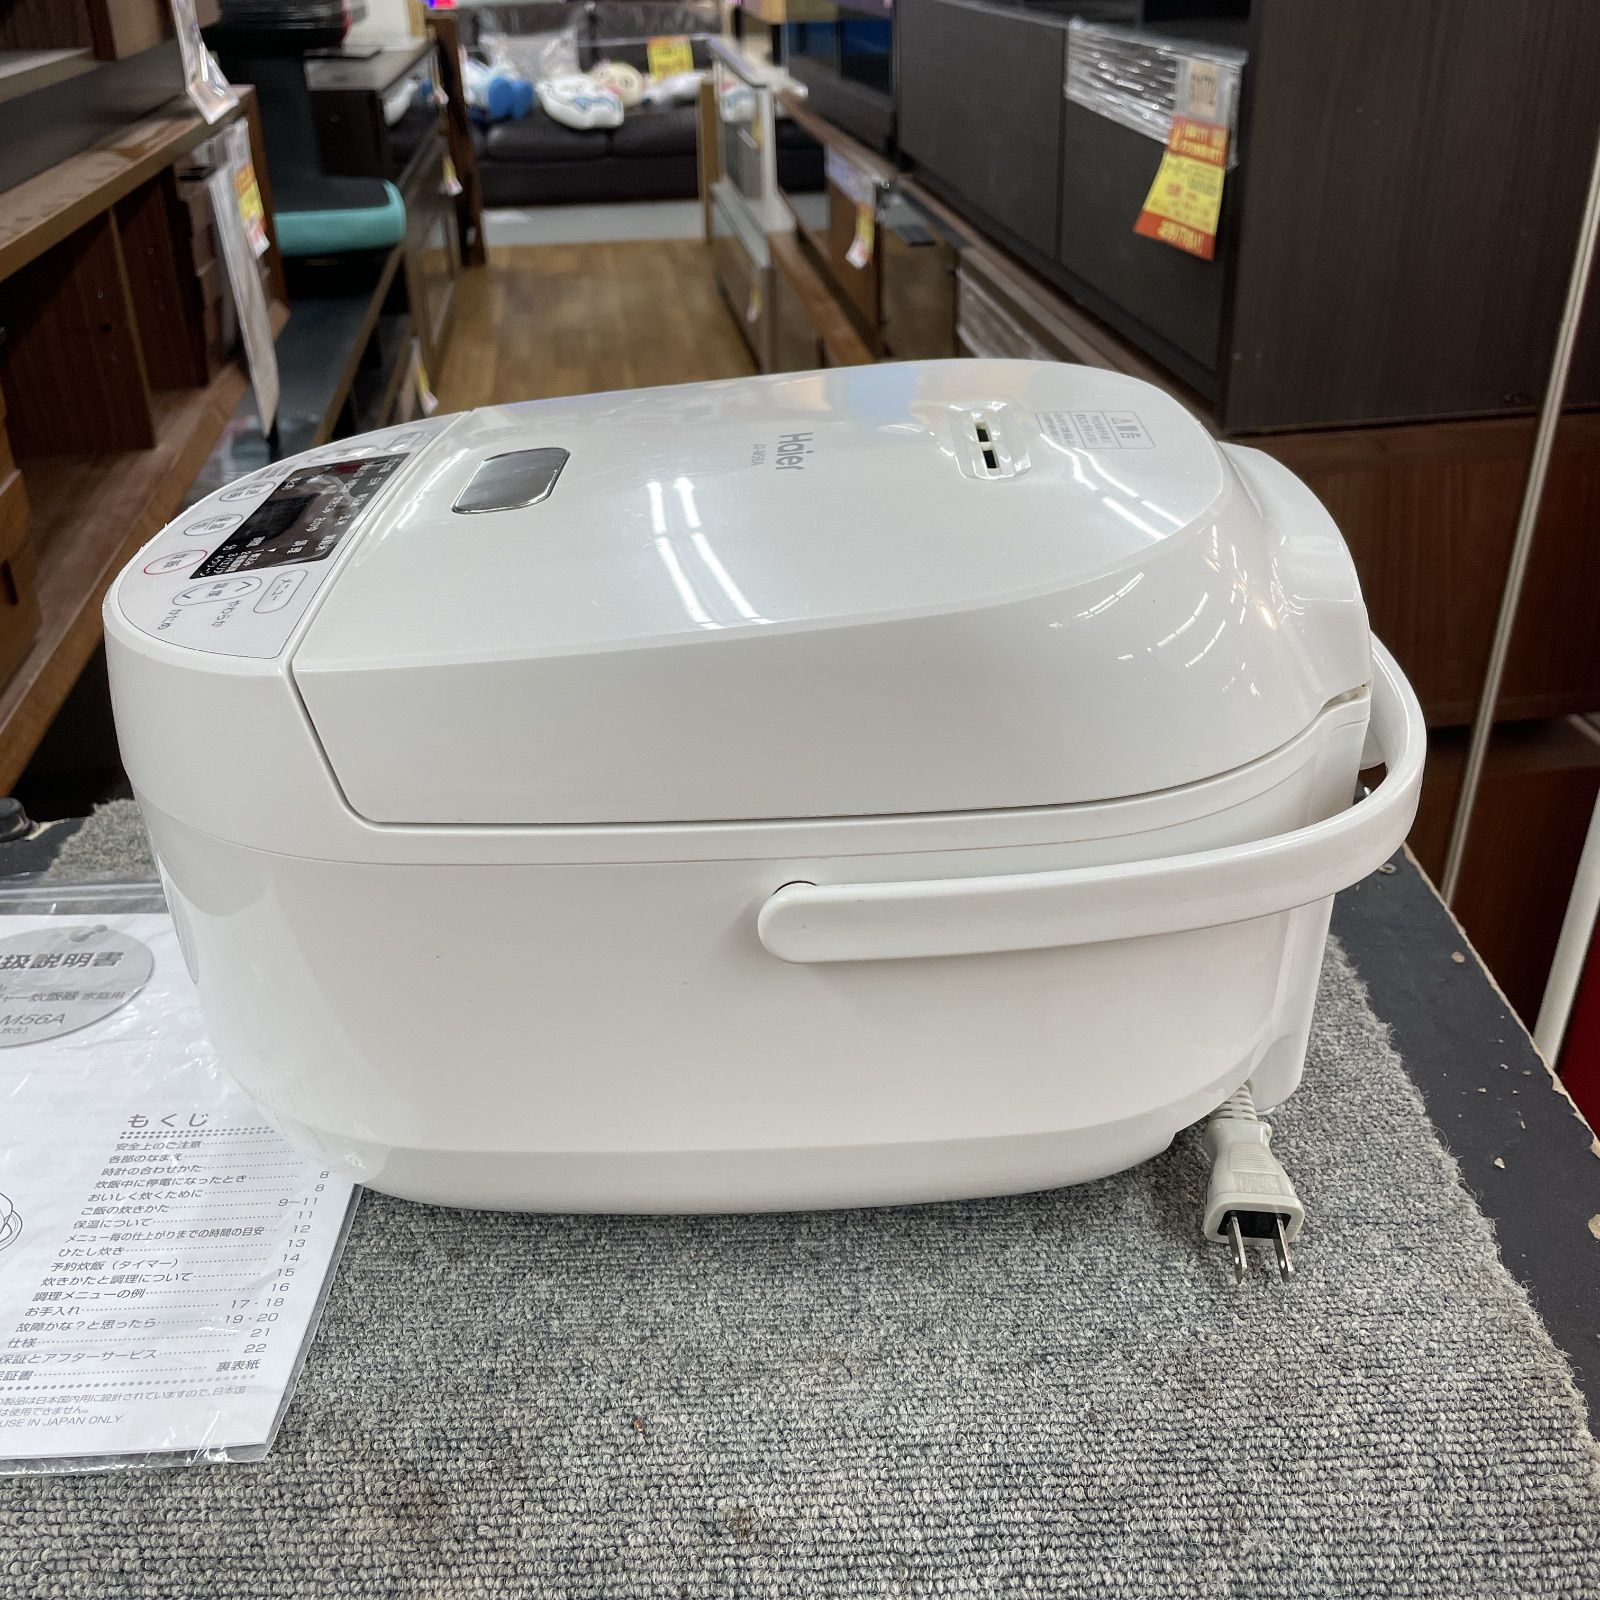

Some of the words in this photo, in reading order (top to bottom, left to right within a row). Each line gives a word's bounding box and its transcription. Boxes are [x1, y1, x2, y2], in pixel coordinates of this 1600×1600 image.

[776, 432, 814, 470] Haier
[271, 578, 293, 602] メニュー
[157, 608, 183, 630] かため
[211, 600, 241, 628] やわらか
[0, 952, 125, 969] 扱説明書
[0, 991, 79, 1003] ャー炊飯器
[128, 1112, 209, 1129] もくじ
[115, 1140, 203, 1151] 安全上のご注意
[101, 1164, 203, 1176] 時計の合わせかた
[94, 1175, 247, 1190] 炊飯中に停電になったとき
[319, 1170, 330, 1180] 8
[87, 1189, 205, 1202] おいしく炊くために
[314, 1184, 325, 1193] 8
[81, 1203, 170, 1216] ご飯の炊きかた
[73, 1217, 154, 1230] 保温について
[299, 1210, 313, 1220] 11
[65, 1226, 265, 1243] メニュー毎の仕上がりまでの時間の目安
[293, 1224, 311, 1234] 12
[58, 1246, 126, 1258] ひたし炊き
[288, 1239, 306, 1248] 13
[283, 1253, 300, 1263] 14
[40, 1272, 194, 1287] 炊きかたと調理について
[277, 1267, 295, 1277] 15
[32, 1288, 147, 1302] 調理メニューの例
[272, 1282, 290, 1292] 16
[25, 1306, 81, 1317] お手入れ
[15, 1318, 157, 1333] 故障かな？と思ったら
[8, 1337, 38, 1349] 仕様
[250, 1327, 271, 1338] 21
[0, 1349, 158, 1365] 保証とアフターサービス
[243, 1343, 267, 1354] 22
[216, 1359, 262, 1373] 裏表紙
[0, 1418, 26, 1428] USE
[27, 1417, 41, 1427] IN
[42, 1415, 87, 1427] JAPAN
[88, 1414, 124, 1425] ONLY
